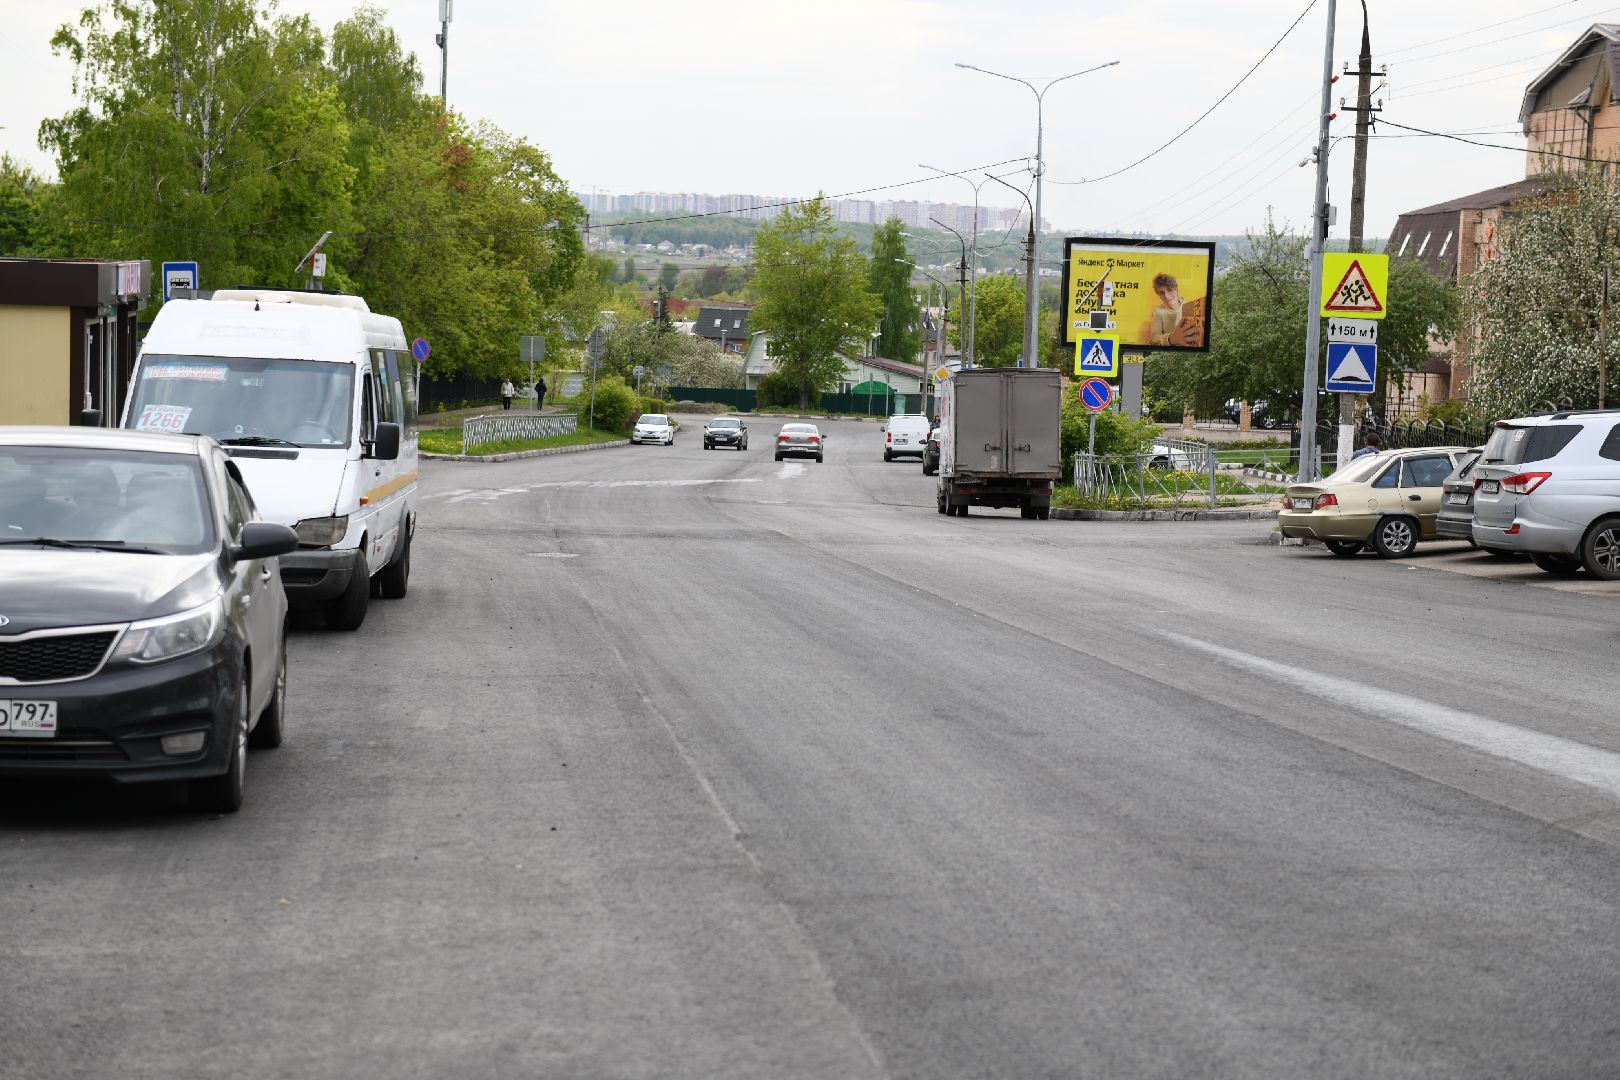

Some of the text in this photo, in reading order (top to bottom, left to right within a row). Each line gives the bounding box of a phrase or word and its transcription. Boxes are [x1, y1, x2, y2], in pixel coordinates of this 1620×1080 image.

[1116, 259, 1145, 268] Маркет
[1077, 278, 1139, 290] Бестная
[1075, 289, 1126, 298] доска
[1339, 326, 1356, 336] 150
[141, 412, 185, 428] 1266
[13, 702, 50, 721] 797
[21, 720, 41, 728] RUS
